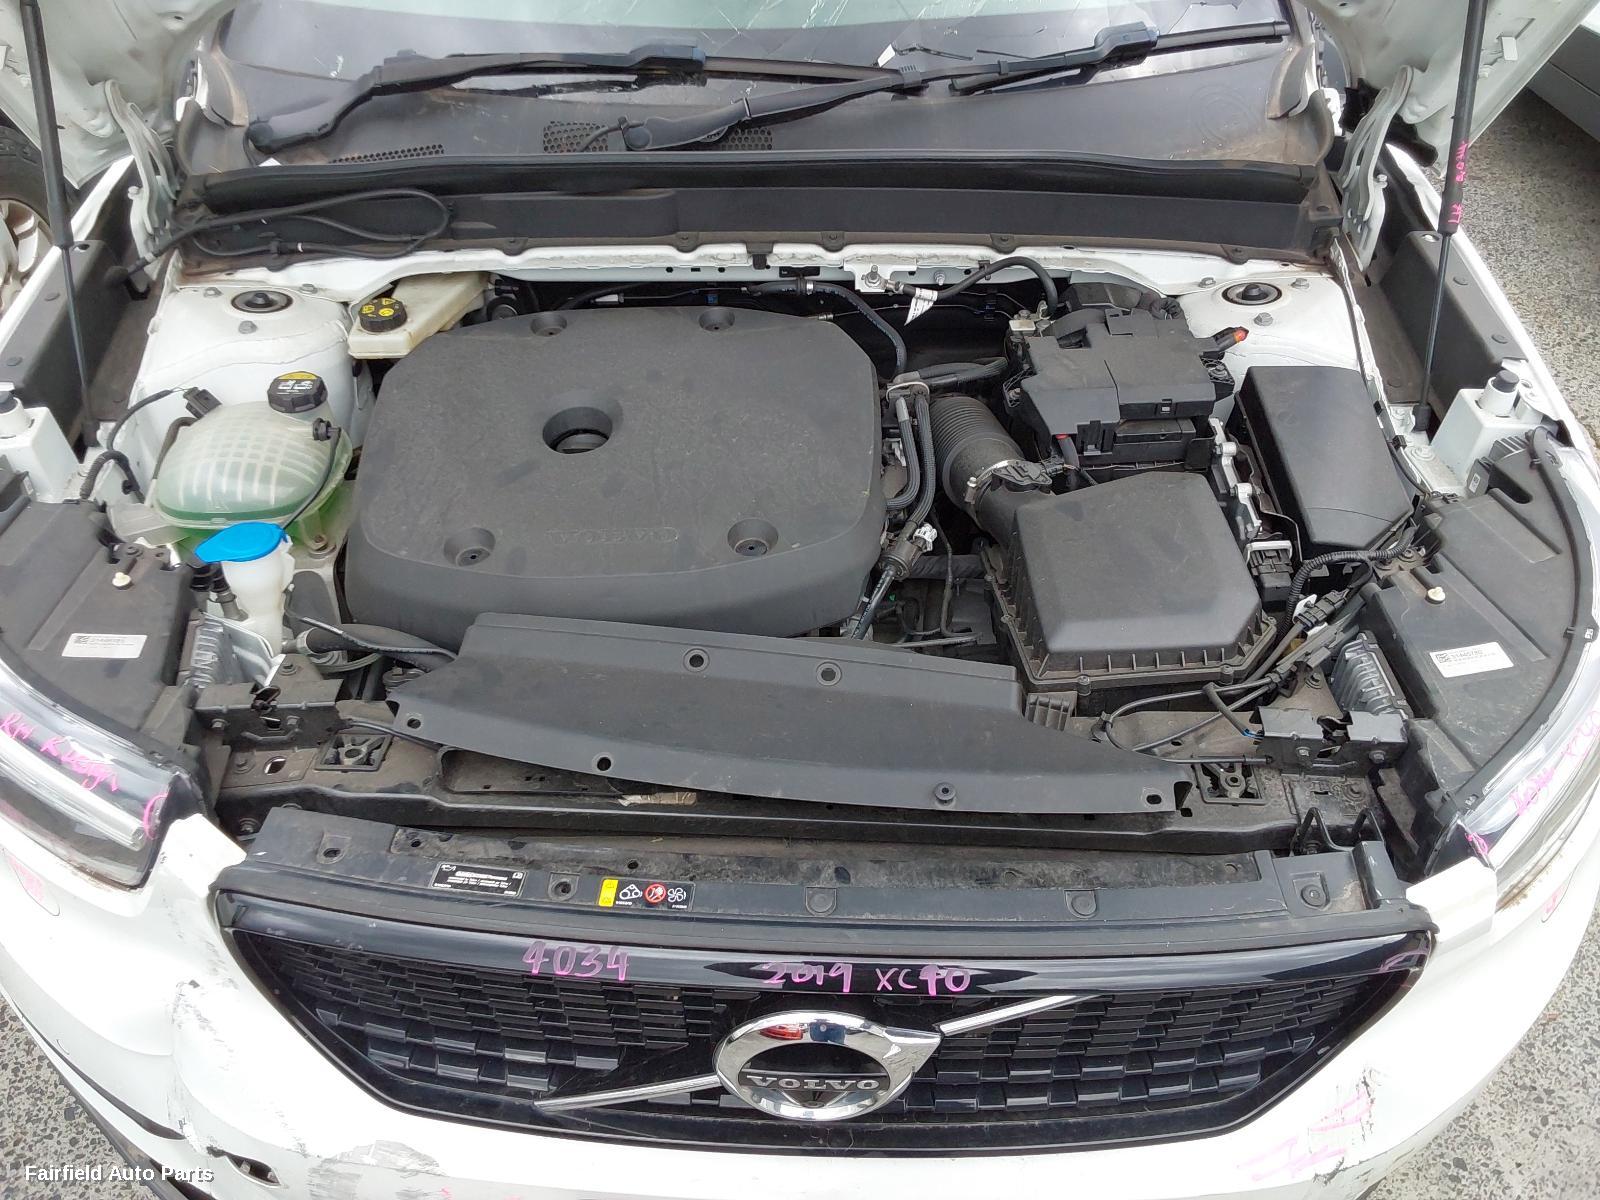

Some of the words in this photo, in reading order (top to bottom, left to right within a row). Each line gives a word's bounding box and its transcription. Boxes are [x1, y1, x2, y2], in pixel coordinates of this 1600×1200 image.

[522, 940, 629, 981] 4034
[761, 962, 852, 993] 2019
[875, 963, 972, 996] XC40
[746, 1075, 880, 1090] VOLVO
